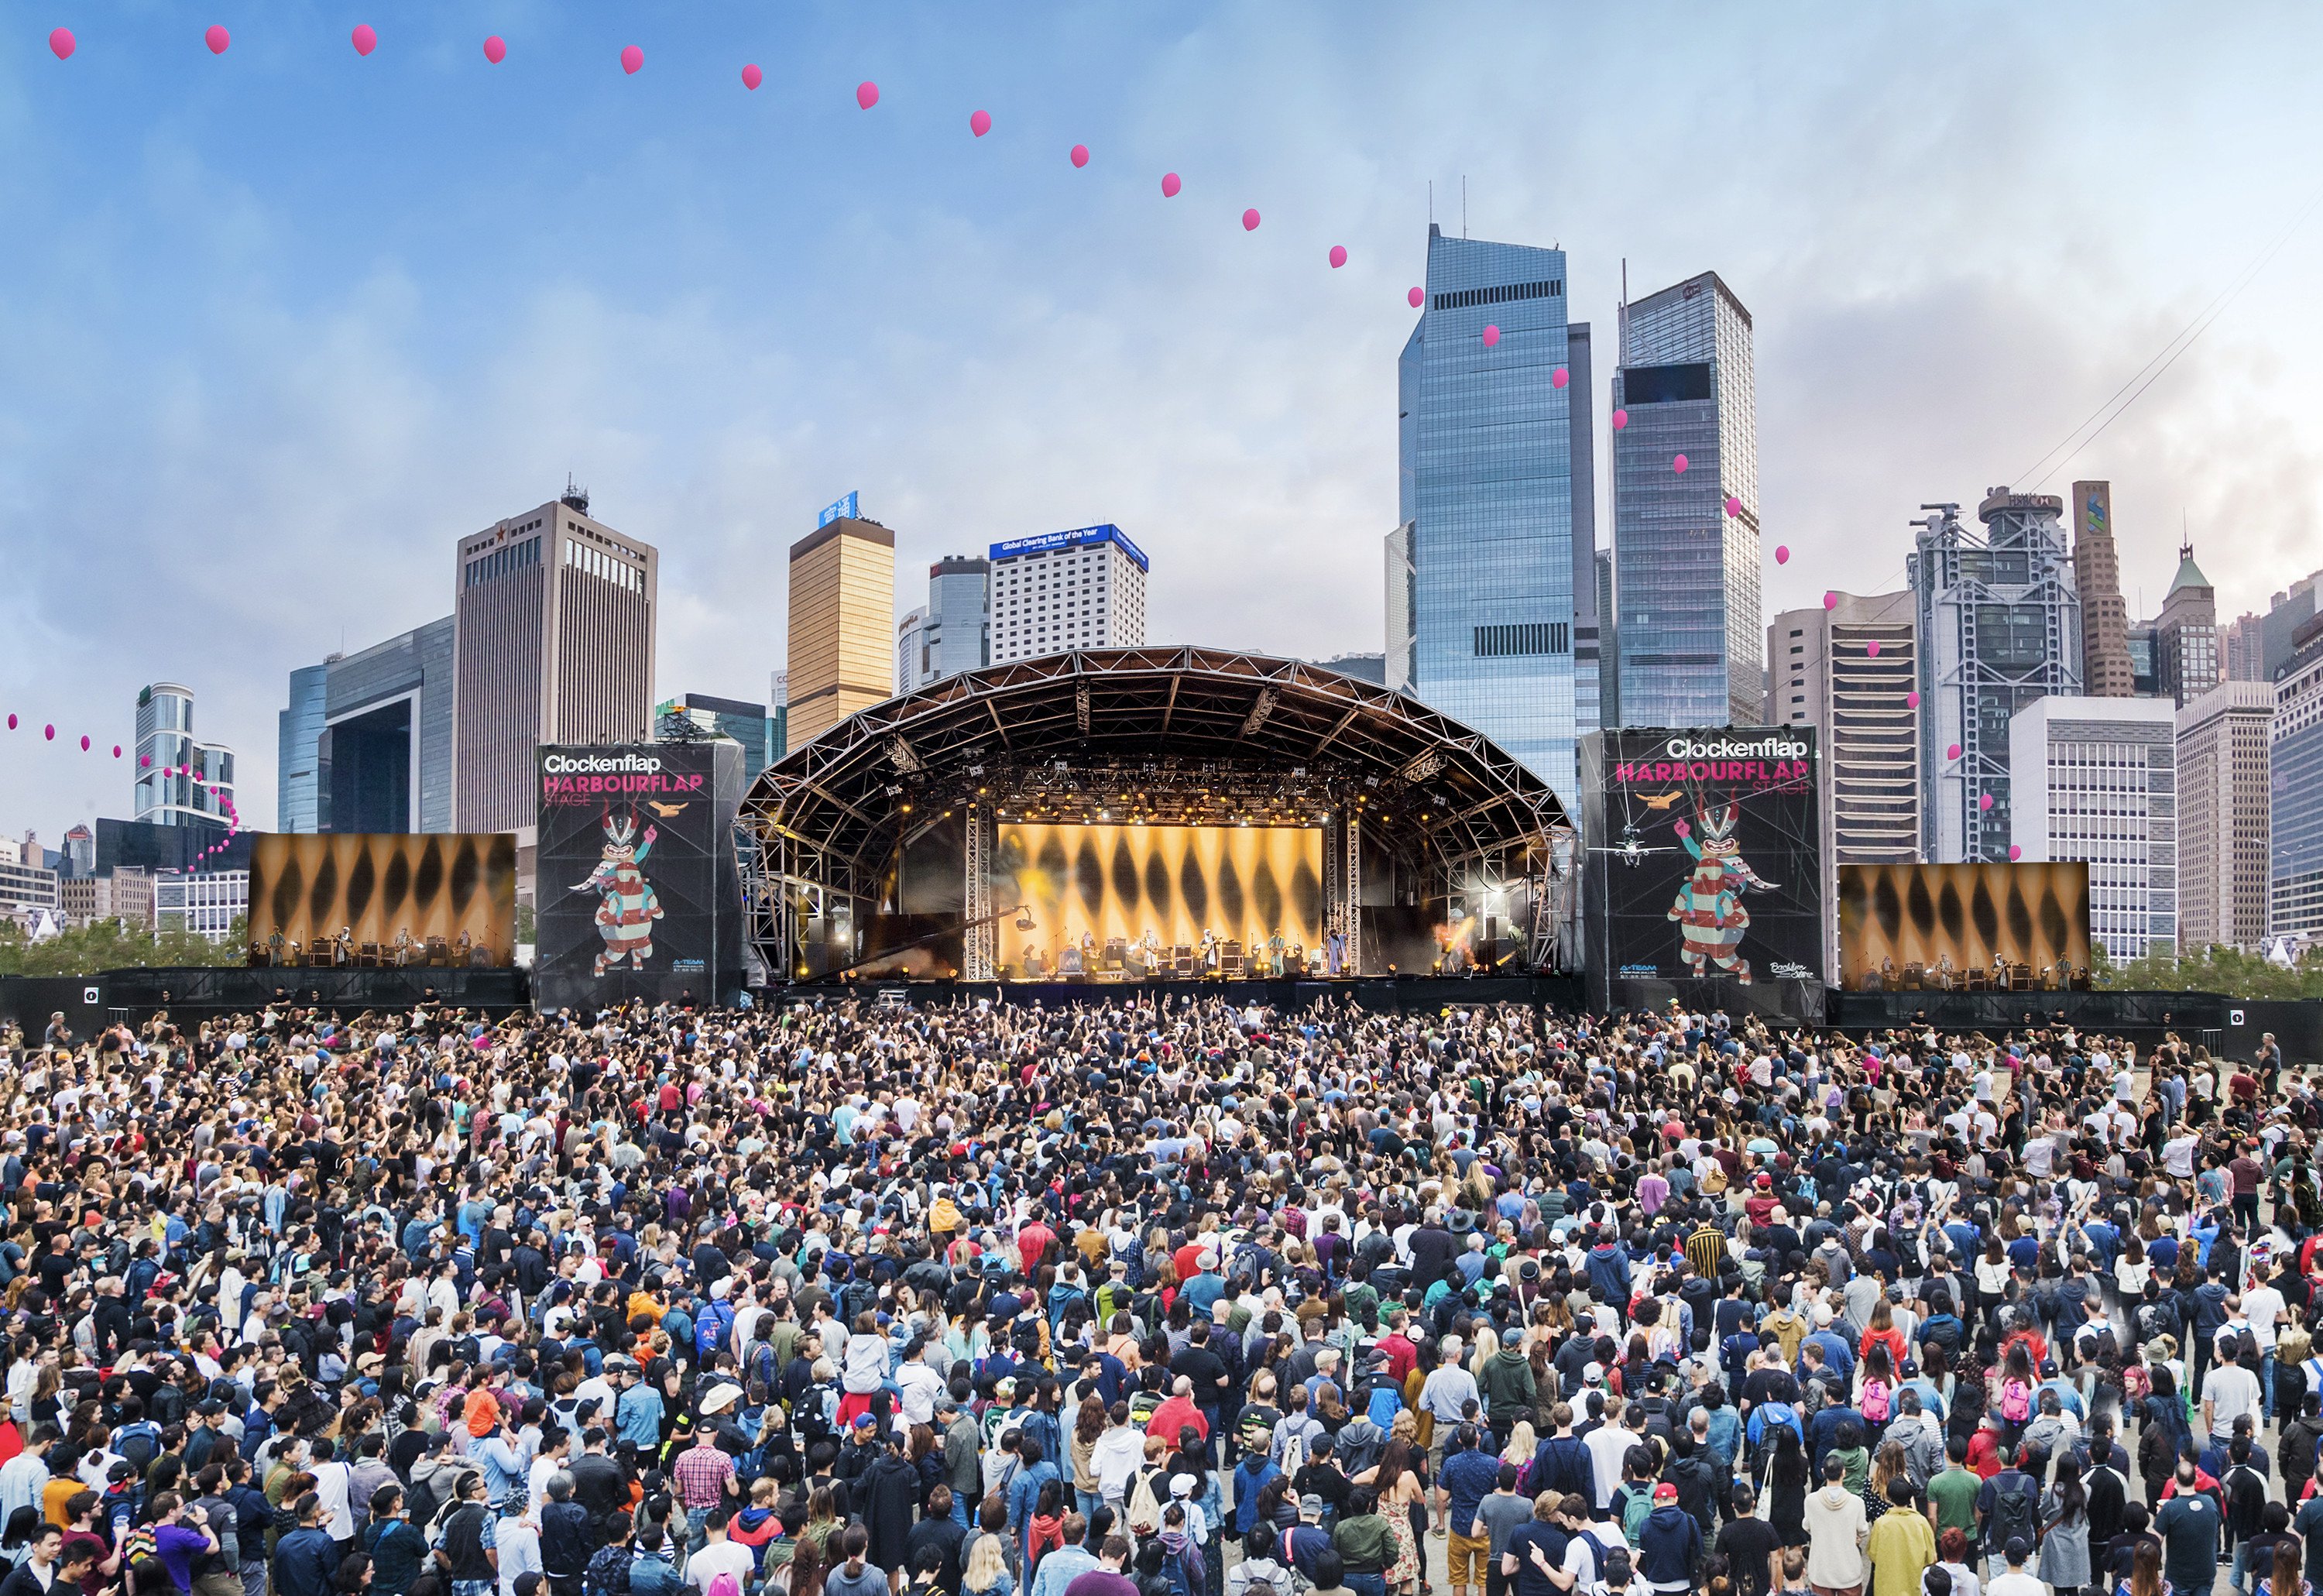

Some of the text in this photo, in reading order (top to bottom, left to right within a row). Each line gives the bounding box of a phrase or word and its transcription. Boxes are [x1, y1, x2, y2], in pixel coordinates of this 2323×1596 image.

[1002, 541, 1021, 551] Global
[1022, 537, 1048, 547] Clearing
[1048, 534, 1064, 542] Bank
[1083, 528, 1098, 537] Year
[1666, 737, 1807, 760] Clockenflap
[544, 753, 661, 775] Clockenflap
[1616, 760, 1809, 782] HARBOURFLAP
[544, 774, 703, 793] HARBOURFLAP
[1752, 780, 1810, 795] STAGE
[544, 793, 591, 807] STAGE
